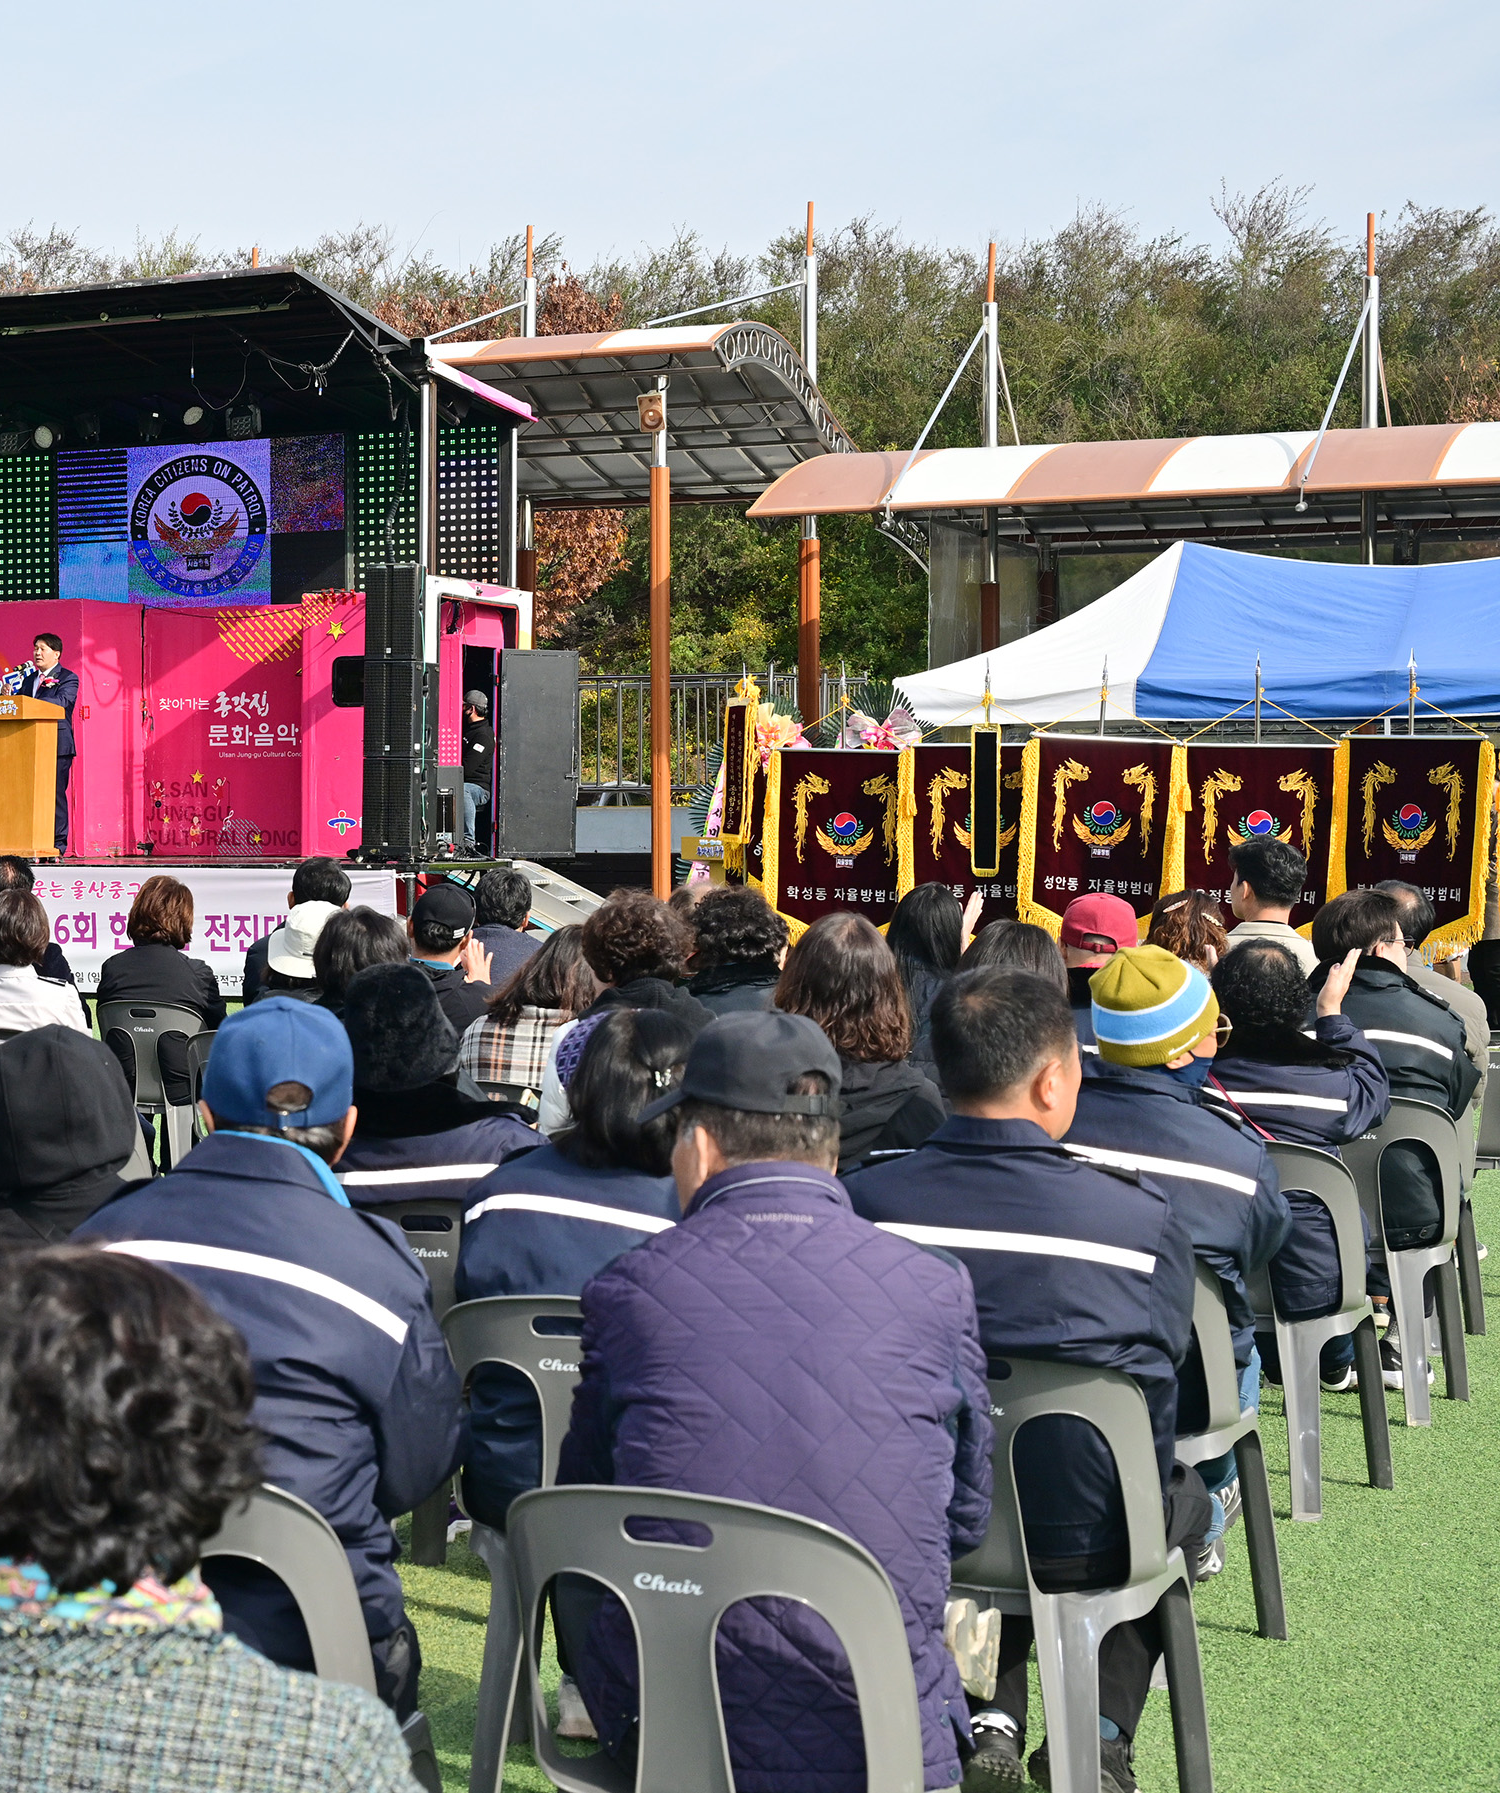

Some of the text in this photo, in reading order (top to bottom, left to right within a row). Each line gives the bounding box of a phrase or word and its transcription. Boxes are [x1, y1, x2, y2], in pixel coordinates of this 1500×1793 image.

[135, 458, 262, 527] KOREA CITIZENS ON PATROL
[5, 669, 33, 693] 도
[158, 690, 270, 719] 찾아가는 종갓집
[208, 722, 302, 747] 문화음악
[236, 751, 262, 759] Jung-gu
[146, 805, 231, 822] JUNG-GU
[786, 885, 899, 903] 학성동 자율방범대
[1044, 875, 1154, 896] 성안동 자율방범대
[1423, 886, 1461, 902] 방범대
[538, 1357, 580, 1372] Chai
[633, 1572, 704, 1596] Chair
